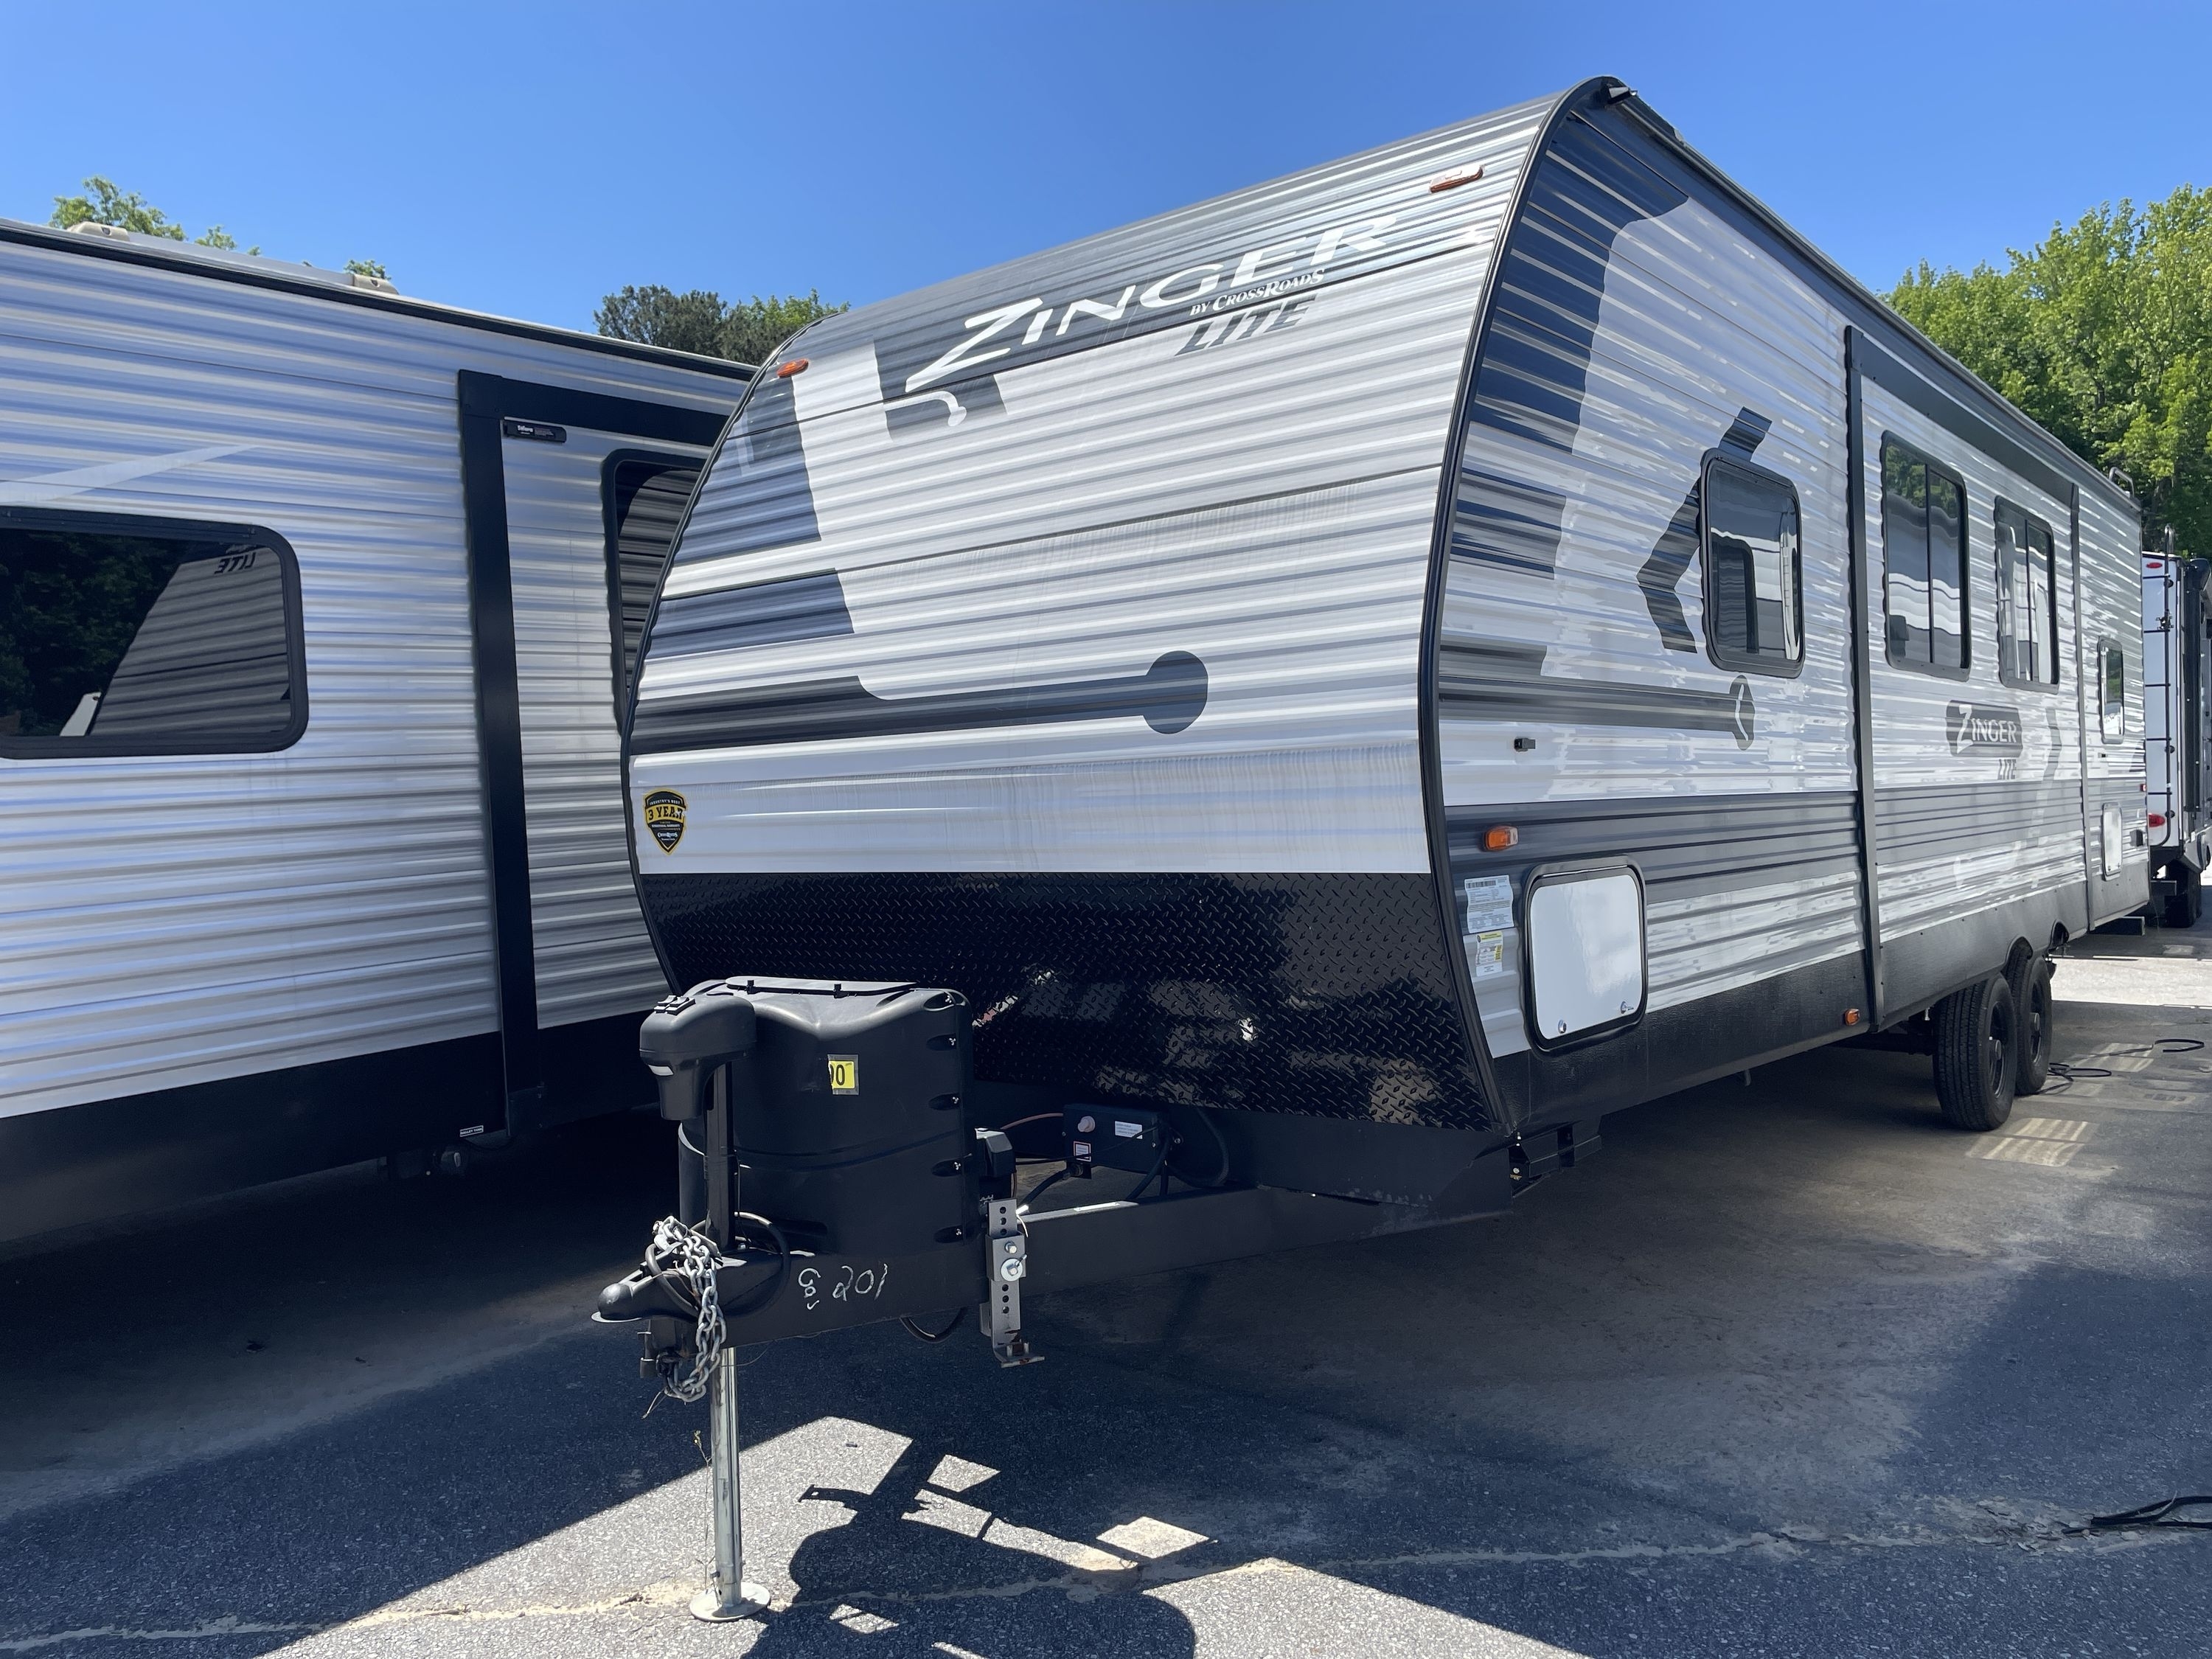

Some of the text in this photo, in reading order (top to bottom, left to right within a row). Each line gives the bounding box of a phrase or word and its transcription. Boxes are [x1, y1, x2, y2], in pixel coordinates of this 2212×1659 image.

[905, 215, 1399, 393] ZINGER
[1189, 301, 1211, 316] BY
[1173, 293, 1318, 357] LITE
[1957, 703, 2017, 754] ZINGER
[1997, 759, 2017, 780] LITE
[648, 806, 683, 821] 3 YEAR
[832, 1263, 888, 1301] 201
